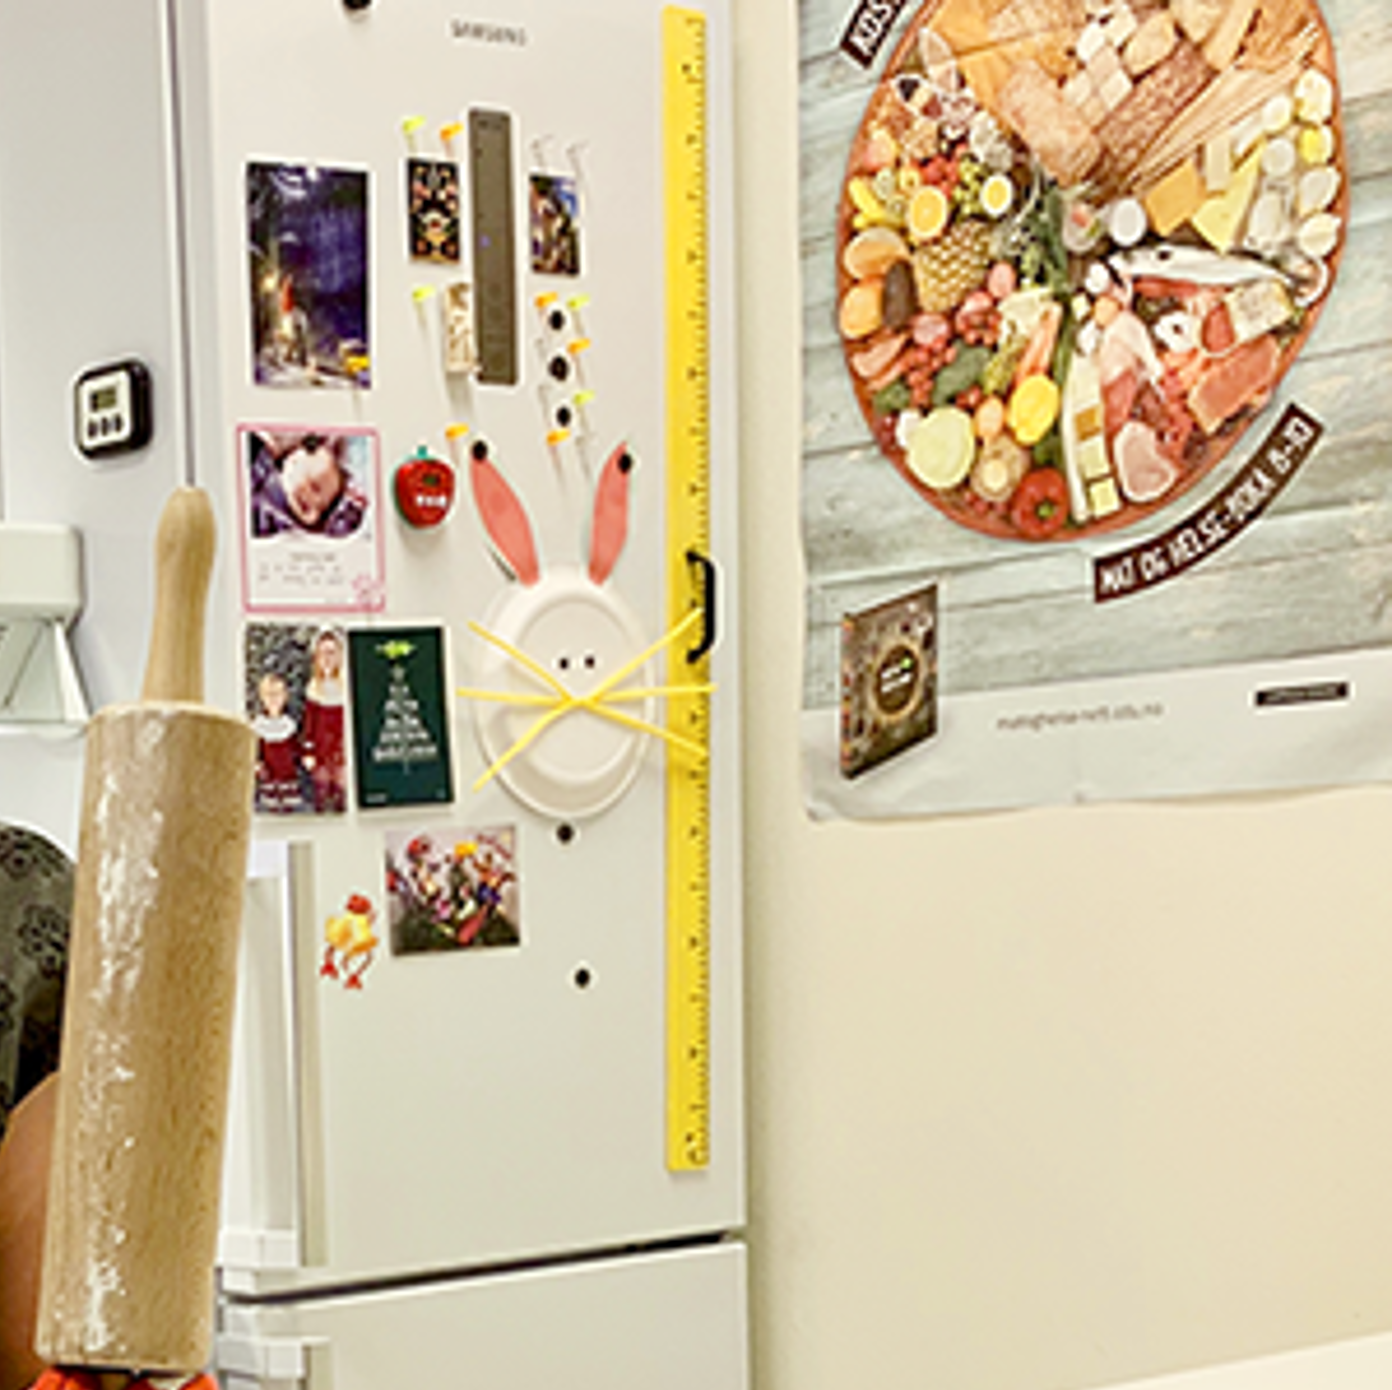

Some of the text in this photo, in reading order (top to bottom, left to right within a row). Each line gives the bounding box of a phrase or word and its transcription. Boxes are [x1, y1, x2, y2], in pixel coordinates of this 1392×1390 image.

[450, 18, 527, 47] SAMSUNG
[848, 0, 894, 56] KOS
[1098, 556, 1134, 592] MAT
[1140, 547, 1169, 580] OG
